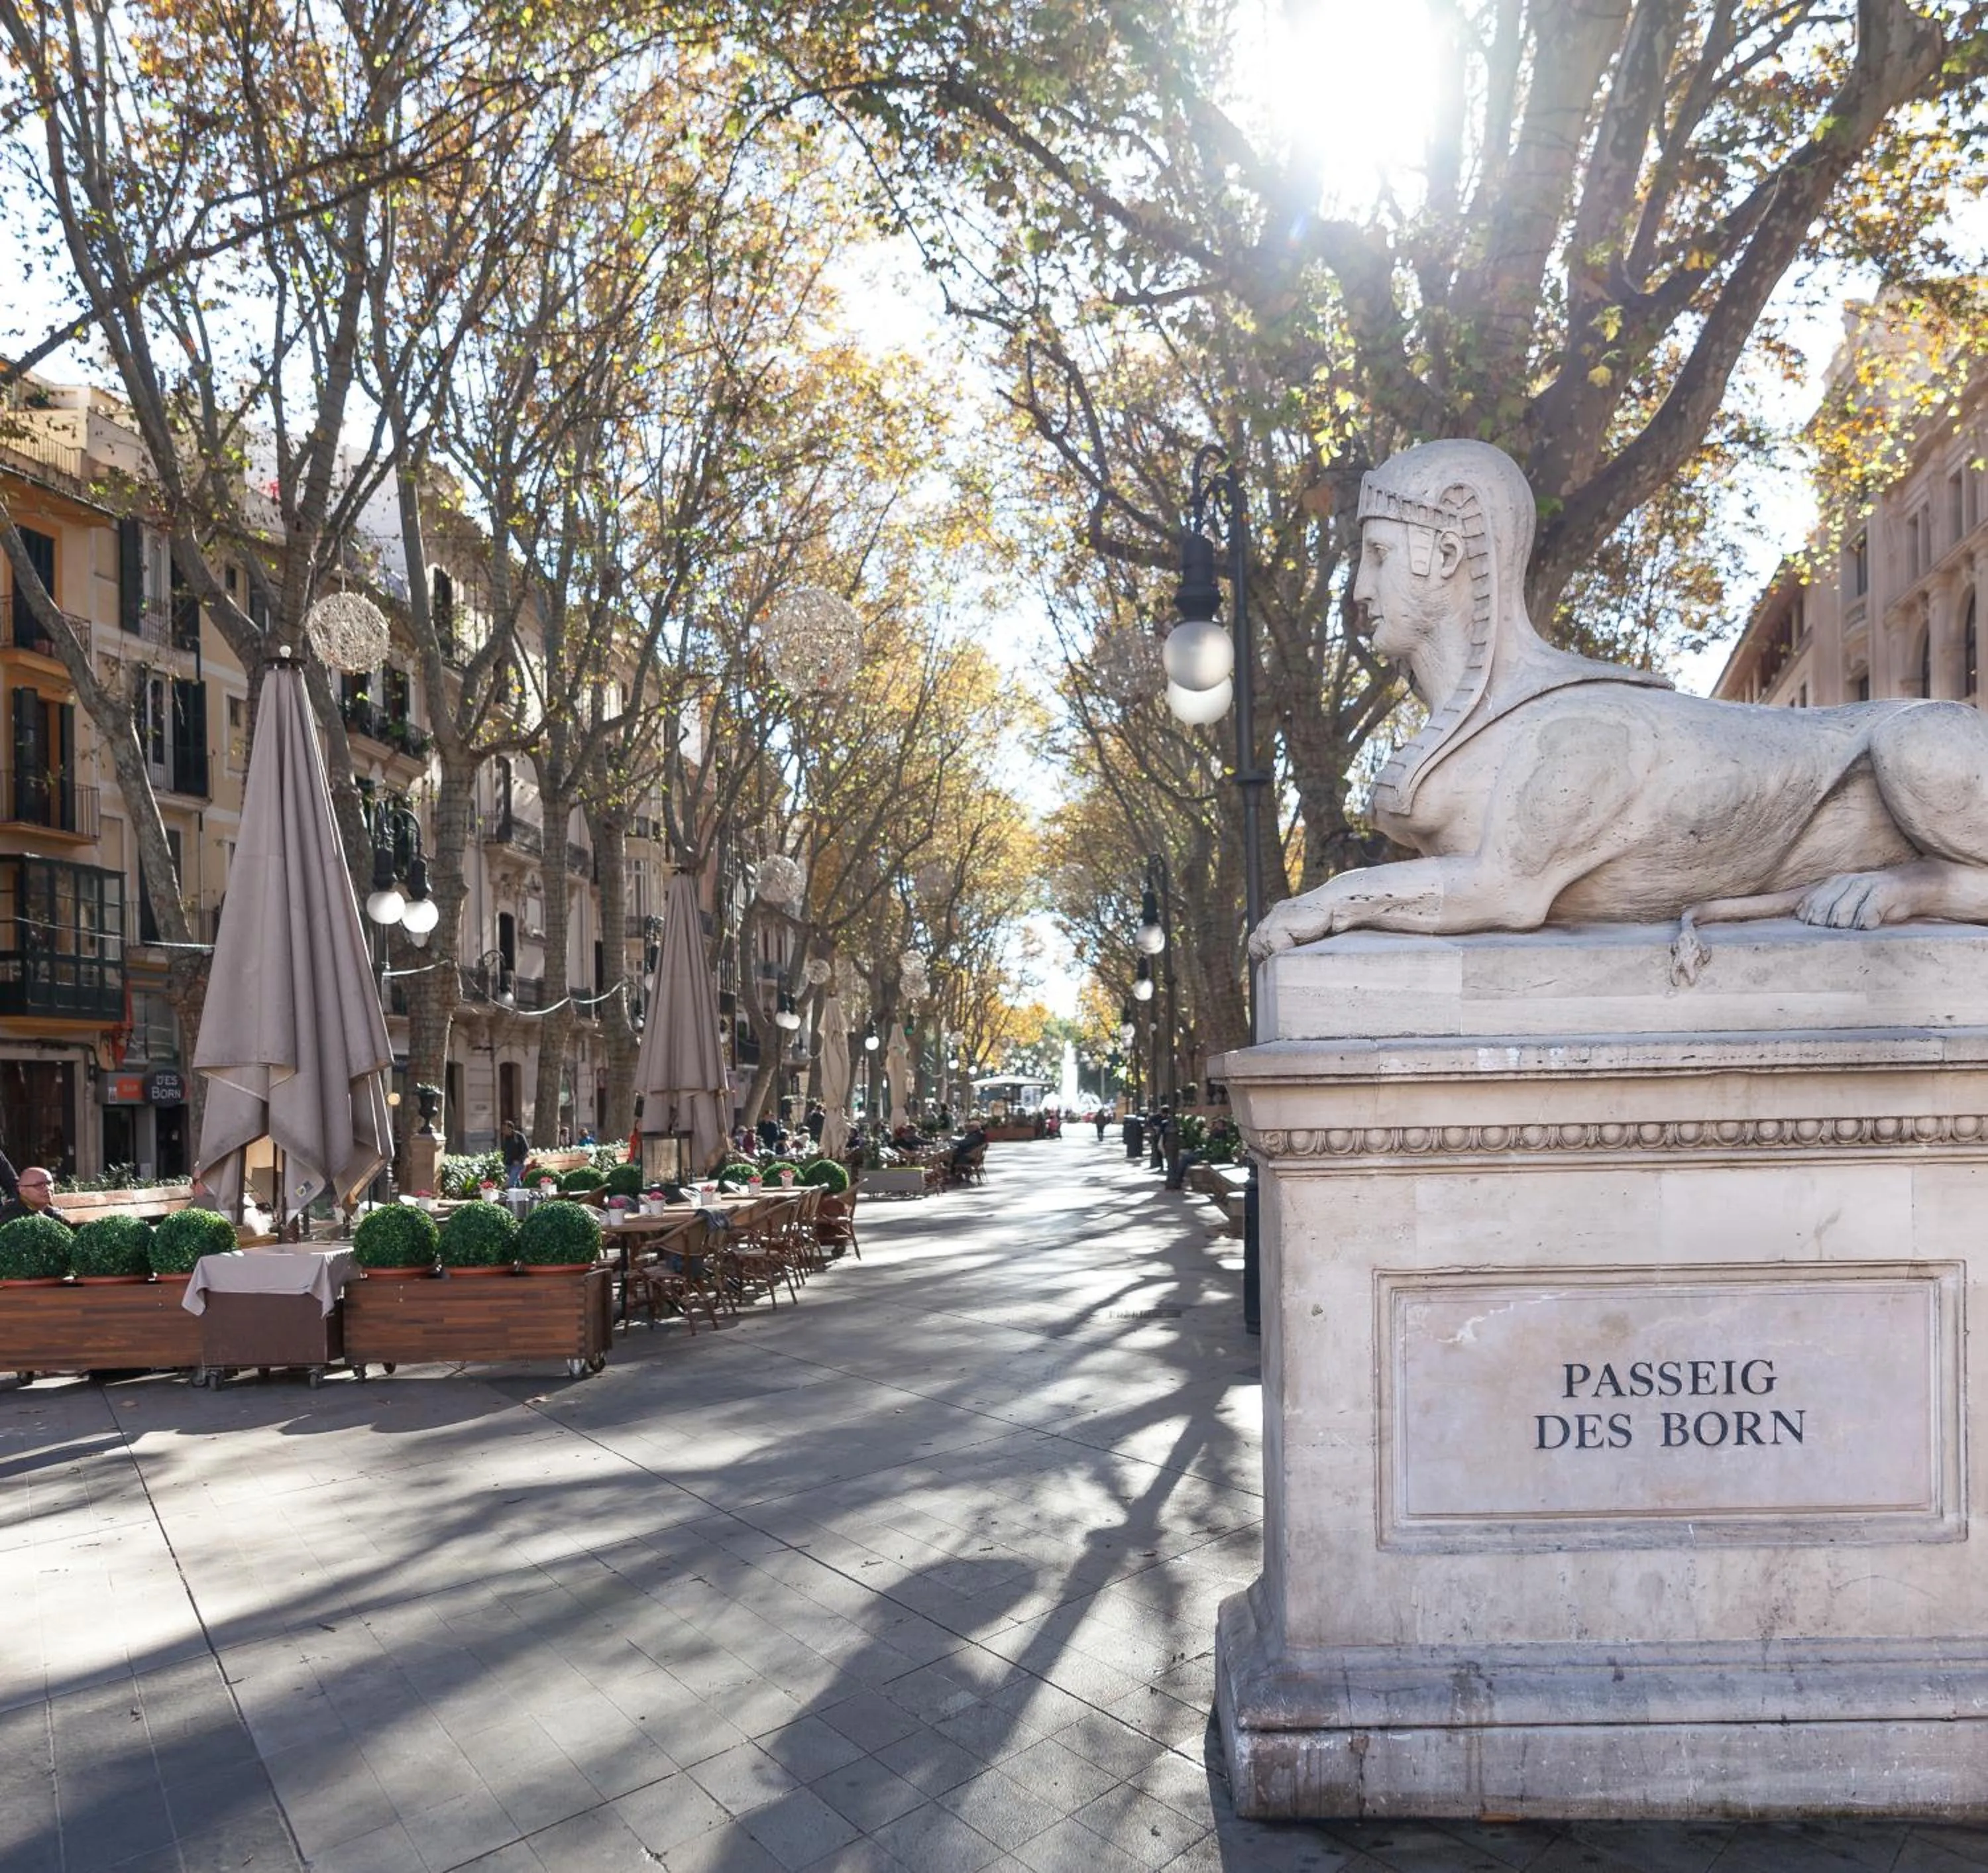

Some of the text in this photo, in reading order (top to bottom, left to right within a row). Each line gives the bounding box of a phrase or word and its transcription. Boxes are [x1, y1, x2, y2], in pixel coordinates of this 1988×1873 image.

[151, 1086, 181, 1100] BORN
[1562, 1359, 1779, 1398] PASSEIG
[1534, 1410, 1807, 1450] DES BORN
